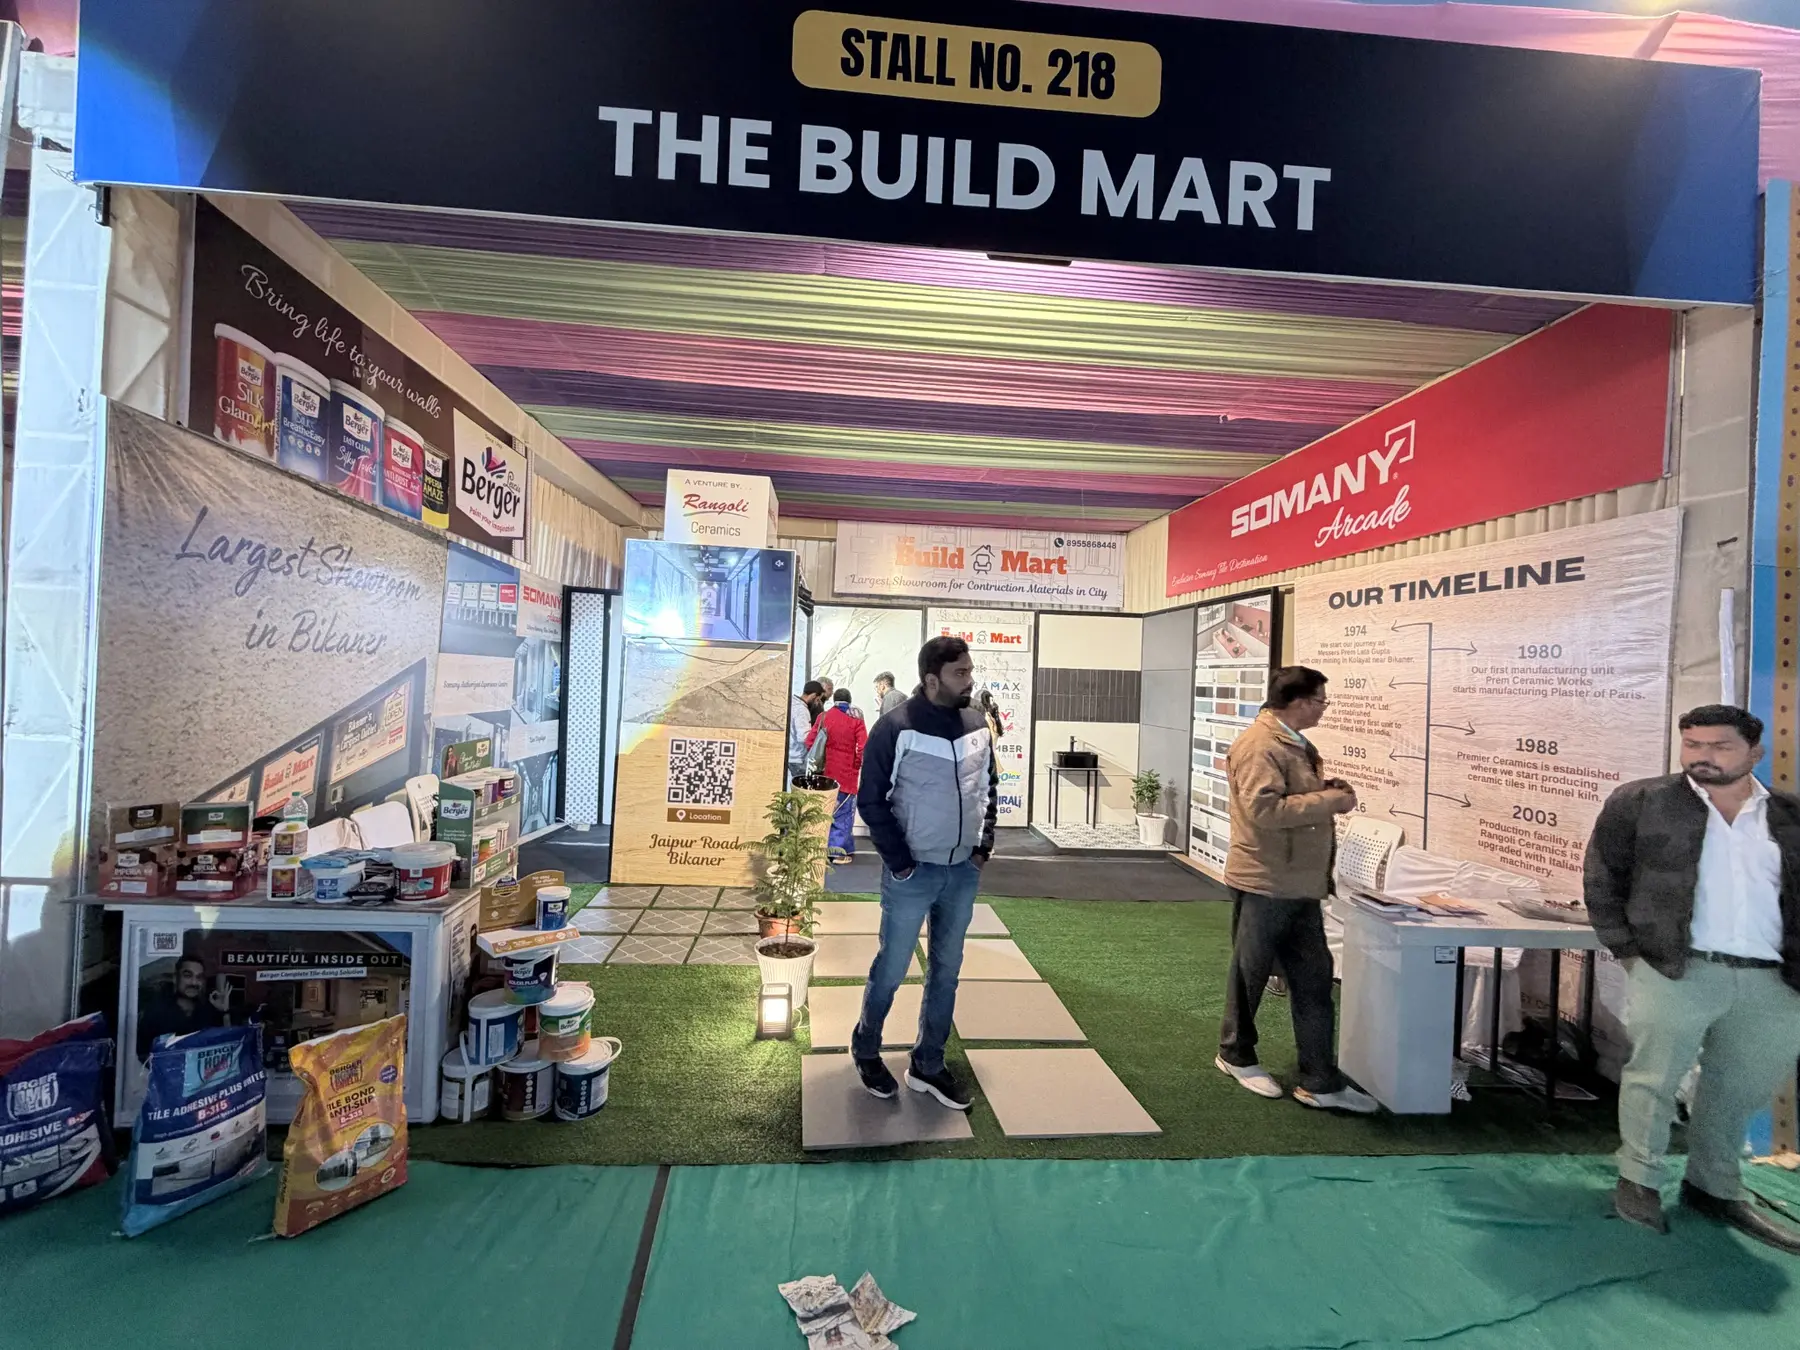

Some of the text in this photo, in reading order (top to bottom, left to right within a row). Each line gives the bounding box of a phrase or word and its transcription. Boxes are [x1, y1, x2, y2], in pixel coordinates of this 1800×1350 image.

[840, 27, 1116, 100] STALL NO. 218
[597, 105, 1332, 232] THE BUILD MART
[241, 264, 311, 339] Bring
[315, 317, 347, 357] life
[367, 359, 405, 391] your
[407, 389, 442, 419] walls
[240, 366, 261, 383] Berger
[237, 382, 265, 411] SILK
[293, 394, 318, 412] Berger
[282, 416, 326, 447] BreatheEasy
[344, 415, 370, 435] Berger
[392, 448, 411, 463] Berger
[424, 483, 445, 500] AMAZE
[461, 456, 521, 520] Berger
[684, 478, 728, 489] A VENTURE
[1231, 437, 1407, 538] SOMANY
[683, 493, 750, 515] Rangoli
[1314, 485, 1412, 548] Arcade
[691, 520, 742, 538] Ceramics
[174, 505, 421, 601] Largest Showroom
[1066, 539, 1117, 550] 8955868448
[896, 544, 1068, 575] Build Mart
[1229, 554, 1269, 572] Destination
[850, 574, 1108, 601] Largest Showroom for Contruction Materials in City
[1328, 556, 1586, 610] OUR TIMELINE
[523, 585, 562, 610] SOMANY
[245, 608, 388, 656] in Bikaner
[990, 632, 1022, 644] Mart
[1344, 625, 1367, 637] 1974
[1329, 641, 1342, 649] start
[1354, 640, 1377, 650] journey
[1371, 648, 1391, 657] Gupta
[1517, 643, 1563, 660] 1980
[1348, 656, 1371, 665] Kolayat
[1387, 655, 1415, 664] Bikaner.
[1471, 664, 1614, 677] Our first manufacturing unit
[1343, 677, 1367, 689] 1987
[1485, 675, 1593, 687] Prem Ceramic Works
[1002, 692, 1021, 700] TILES
[1370, 694, 1383, 702] unit
[1452, 685, 1645, 700] starts manufacturing Plaster of Paris.
[1342, 716, 1402, 730] the very first to
[1342, 745, 1367, 759] 1993
[1515, 737, 1559, 756] 1988
[1333, 760, 1360, 771] Ceramics
[1386, 769, 1394, 778] is
[1456, 751, 1620, 781] Premier Ceramics is established
[1337, 767, 1345, 776] to
[1345, 769, 1383, 784] manufacture
[1383, 777, 1401, 789] large
[1470, 762, 1599, 793] where we start producing
[1365, 782, 1381, 792] tiles.
[1467, 773, 1603, 804] ceramic tiles in tunnel kiln.
[443, 806, 468, 818] Berger
[690, 812, 722, 821] Location
[1512, 805, 1558, 827] 2003
[649, 834, 698, 853] Jaipur
[1479, 818, 1583, 851] Production facility at
[1480, 828, 1580, 863] Rangoli Ceramics is
[667, 851, 726, 867] Bikaner
[1477, 839, 1583, 874] upgraded with Italian
[1499, 855, 1555, 879] machinery.
[227, 953, 398, 965] BEAUTIFUL INSIDE OUT
[280, 968, 365, 980] Complete Solution
[329, 1059, 363, 1076] BERGER
[147, 1082, 243, 1122] TILE ADHESIVE PLUS
[344, 1086, 376, 1104] BOND
[196, 1099, 229, 1121] B-315
